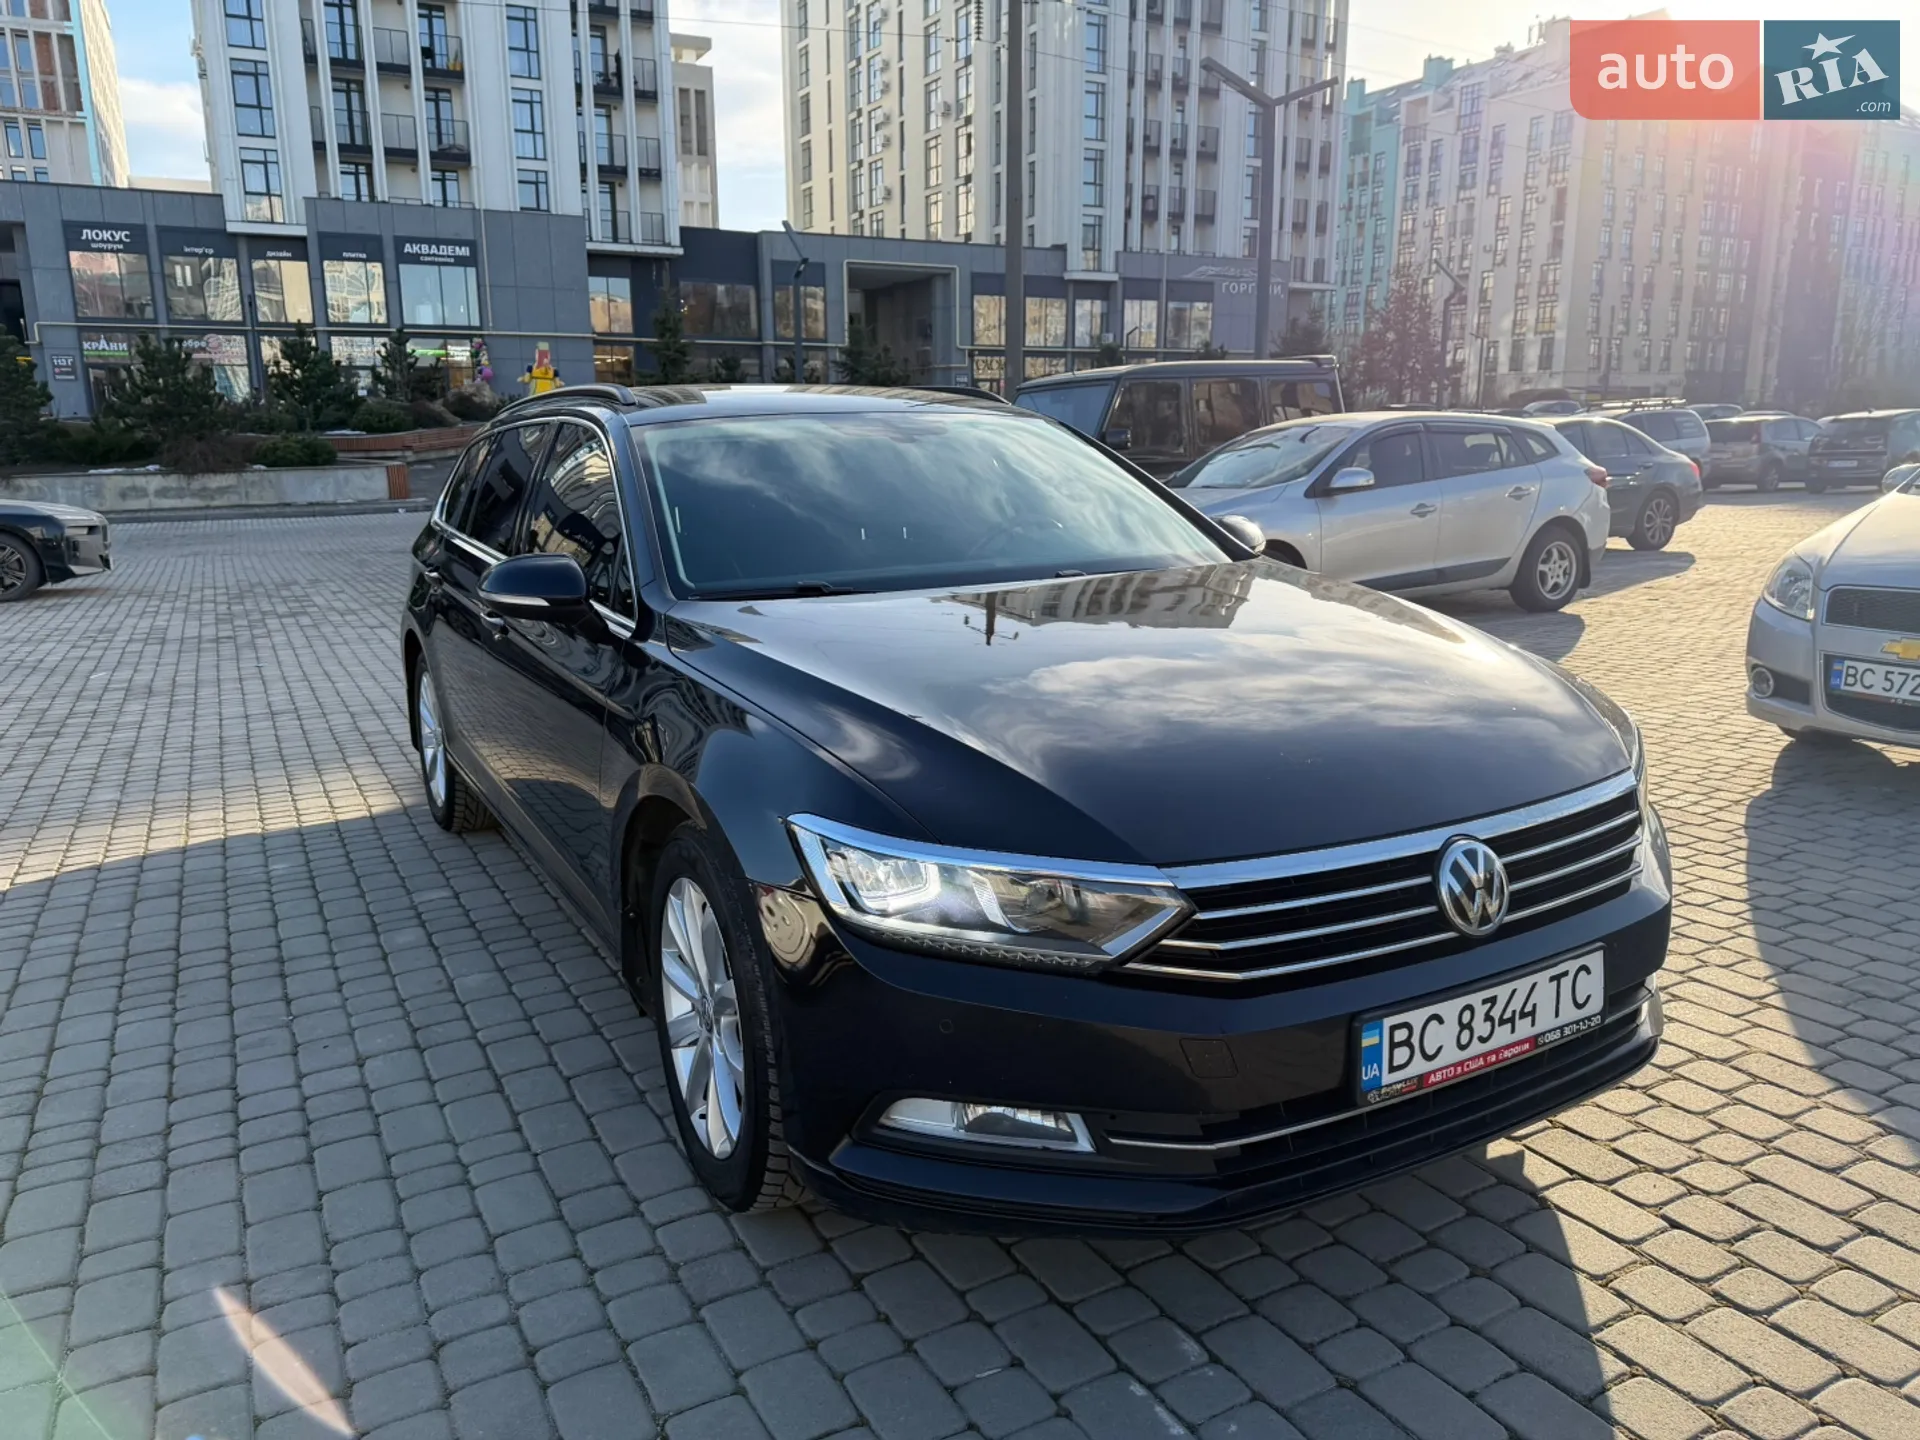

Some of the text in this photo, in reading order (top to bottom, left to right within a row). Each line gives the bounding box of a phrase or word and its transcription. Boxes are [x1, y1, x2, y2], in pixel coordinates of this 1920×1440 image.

[81, 229, 131, 242] ЛОКУС
[403, 243, 470, 257] АКВАДЕМІ
[1845, 665, 1876, 690] BC
[1388, 963, 1592, 1075] BC 8344 TC
[1362, 1063, 1380, 1080] UA
[1428, 1066, 1455, 1084] АВТО
[1463, 1057, 1485, 1073] США
